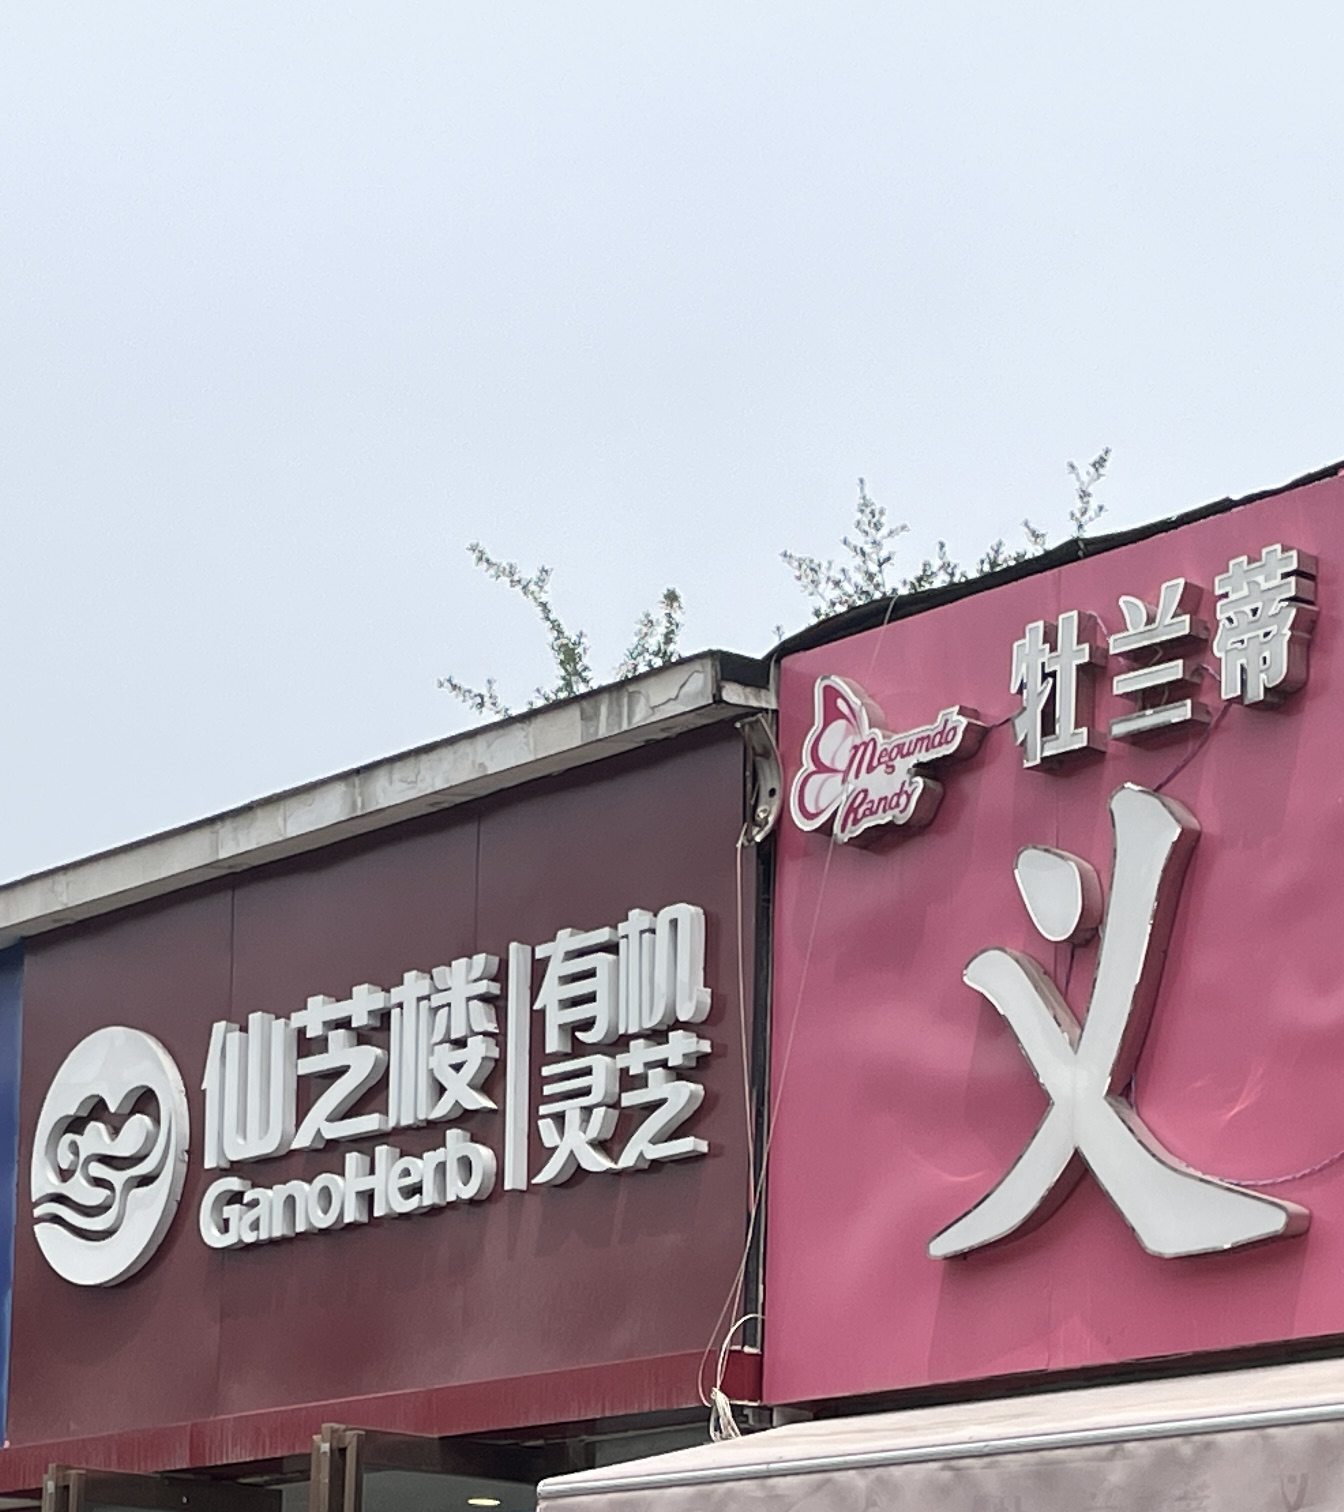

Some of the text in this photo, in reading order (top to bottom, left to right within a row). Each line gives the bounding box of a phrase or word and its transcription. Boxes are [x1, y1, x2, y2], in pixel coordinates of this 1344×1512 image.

[1010, 543, 1318, 770] 牡兰蒂
[532, 903, 712, 1054] 有机
[201, 953, 501, 1169] 仙芝楼
[532, 1031, 712, 1186] 灵芝
[199, 1129, 497, 1249] GanoHerb
